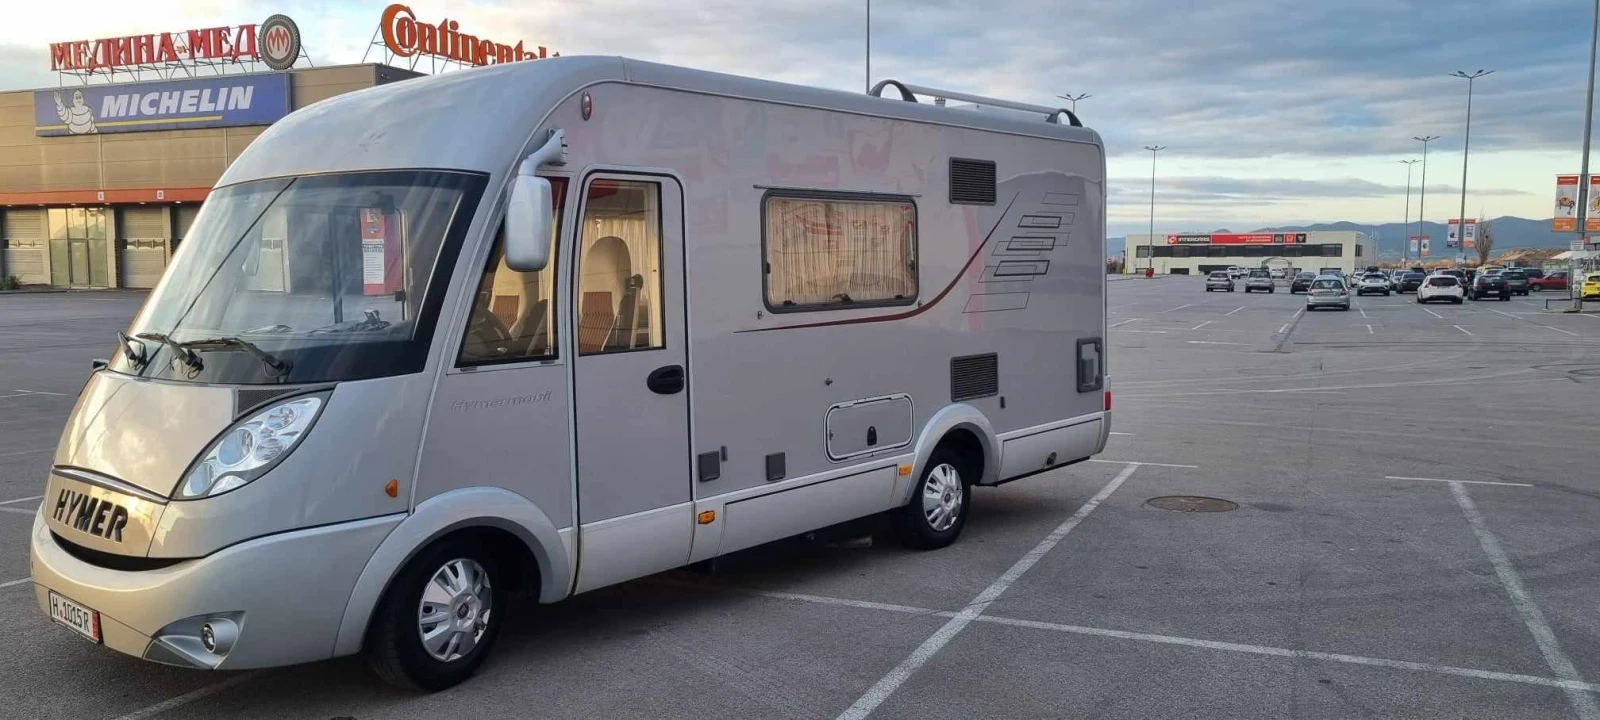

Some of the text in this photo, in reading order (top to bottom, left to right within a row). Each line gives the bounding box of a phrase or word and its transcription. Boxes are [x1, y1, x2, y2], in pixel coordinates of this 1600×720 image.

[50, 24, 260, 76] МЕДИНА МЕД
[381, 4, 546, 66] Continent
[101, 86, 254, 118] MICHELIN
[53, 488, 129, 543] HYMER
